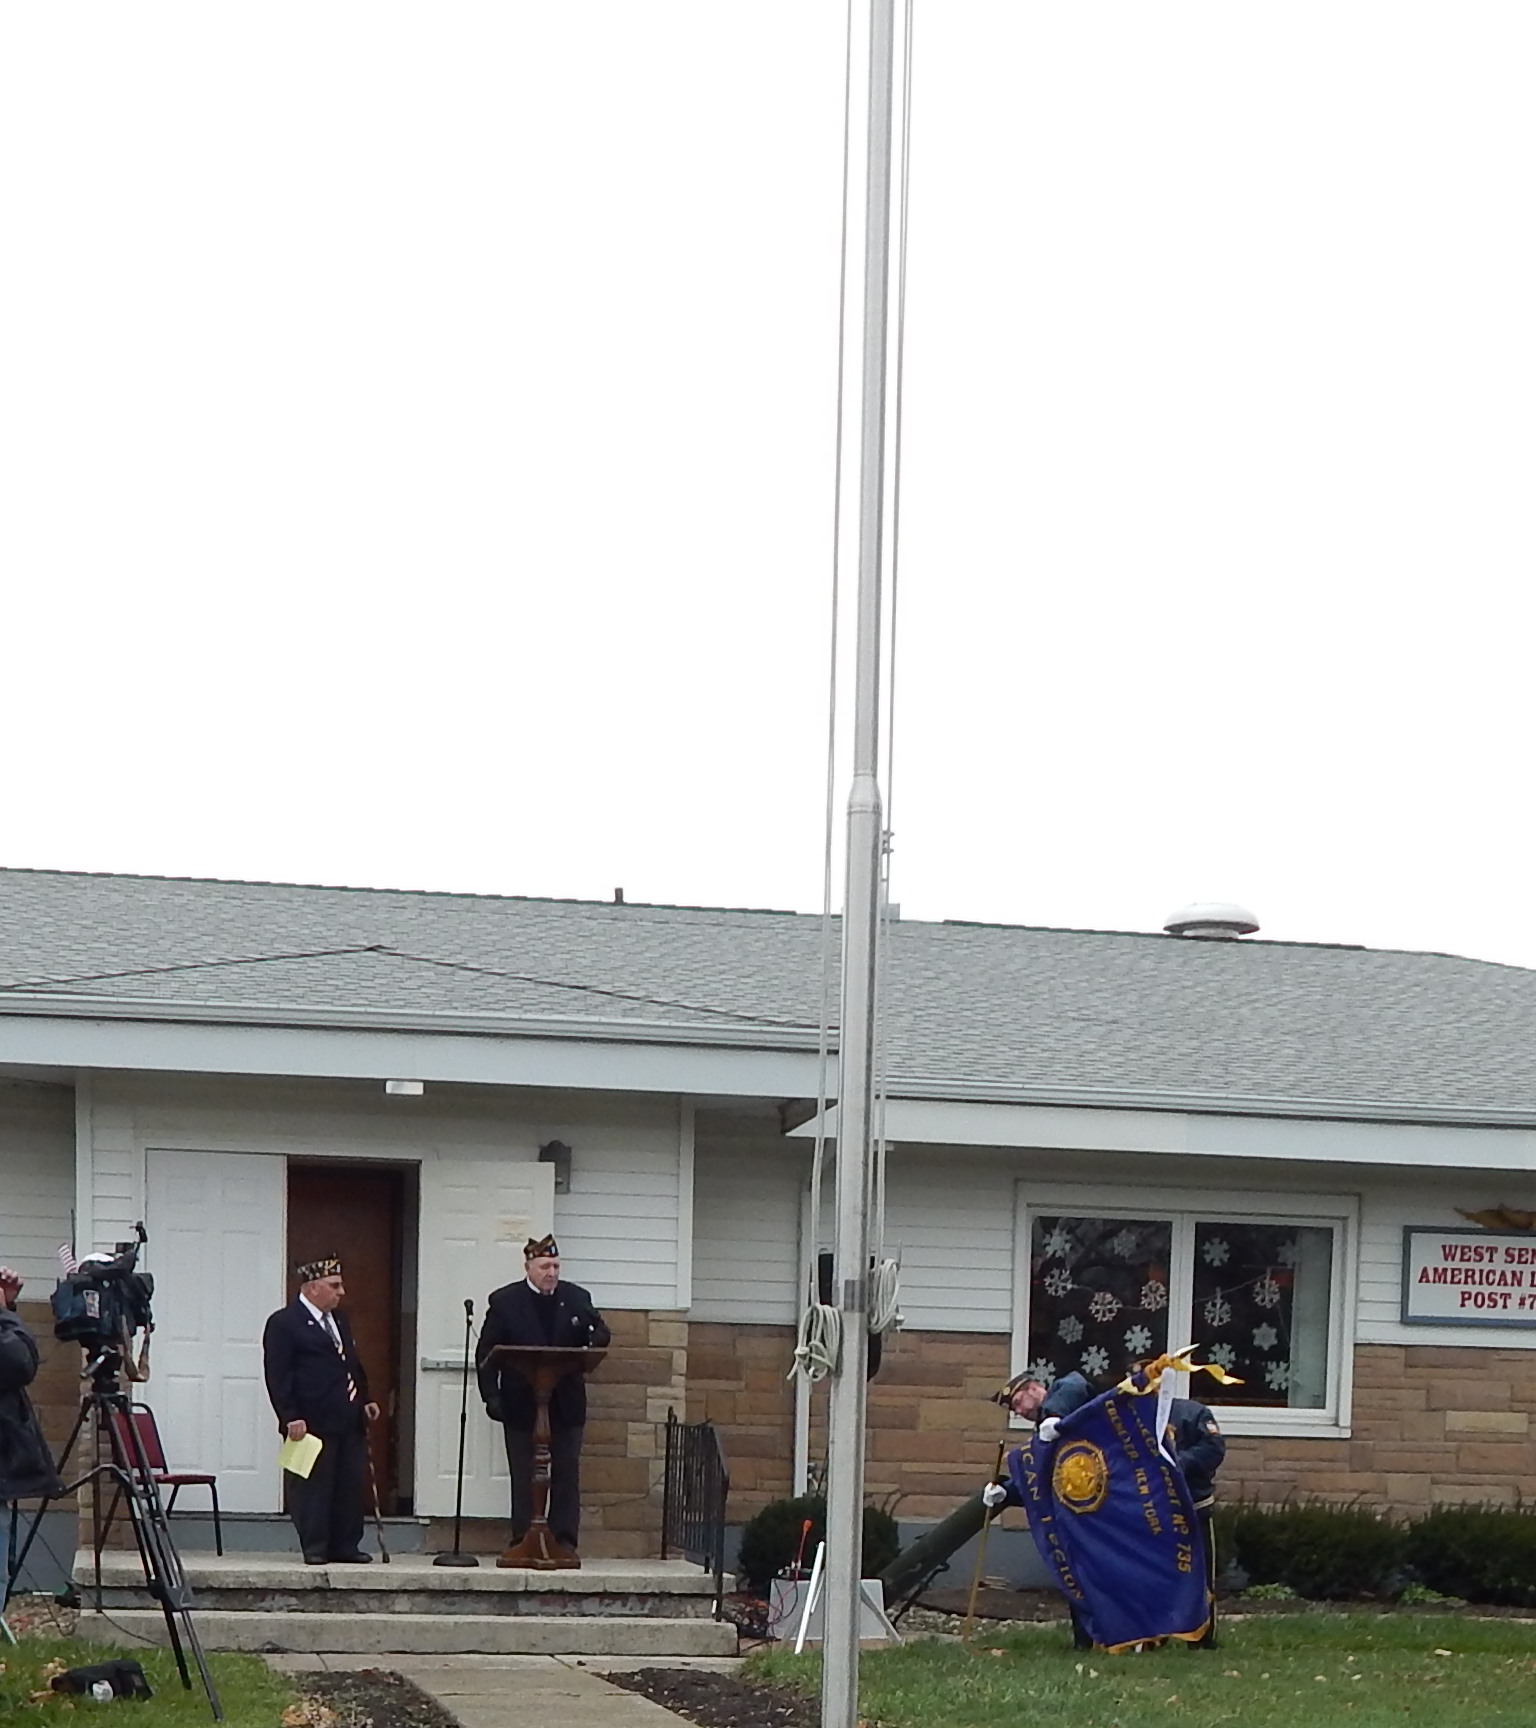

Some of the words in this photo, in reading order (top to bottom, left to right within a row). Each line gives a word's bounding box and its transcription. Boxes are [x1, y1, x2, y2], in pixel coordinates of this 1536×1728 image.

[1441, 1244, 1499, 1264] WEST
[1418, 1266, 1523, 1288] AMERICAN
[1459, 1290, 1512, 1309] POST
[1134, 1467, 1150, 1495] NEW
[1143, 1500, 1164, 1536] YORK
[1176, 1543, 1192, 1574] 735
